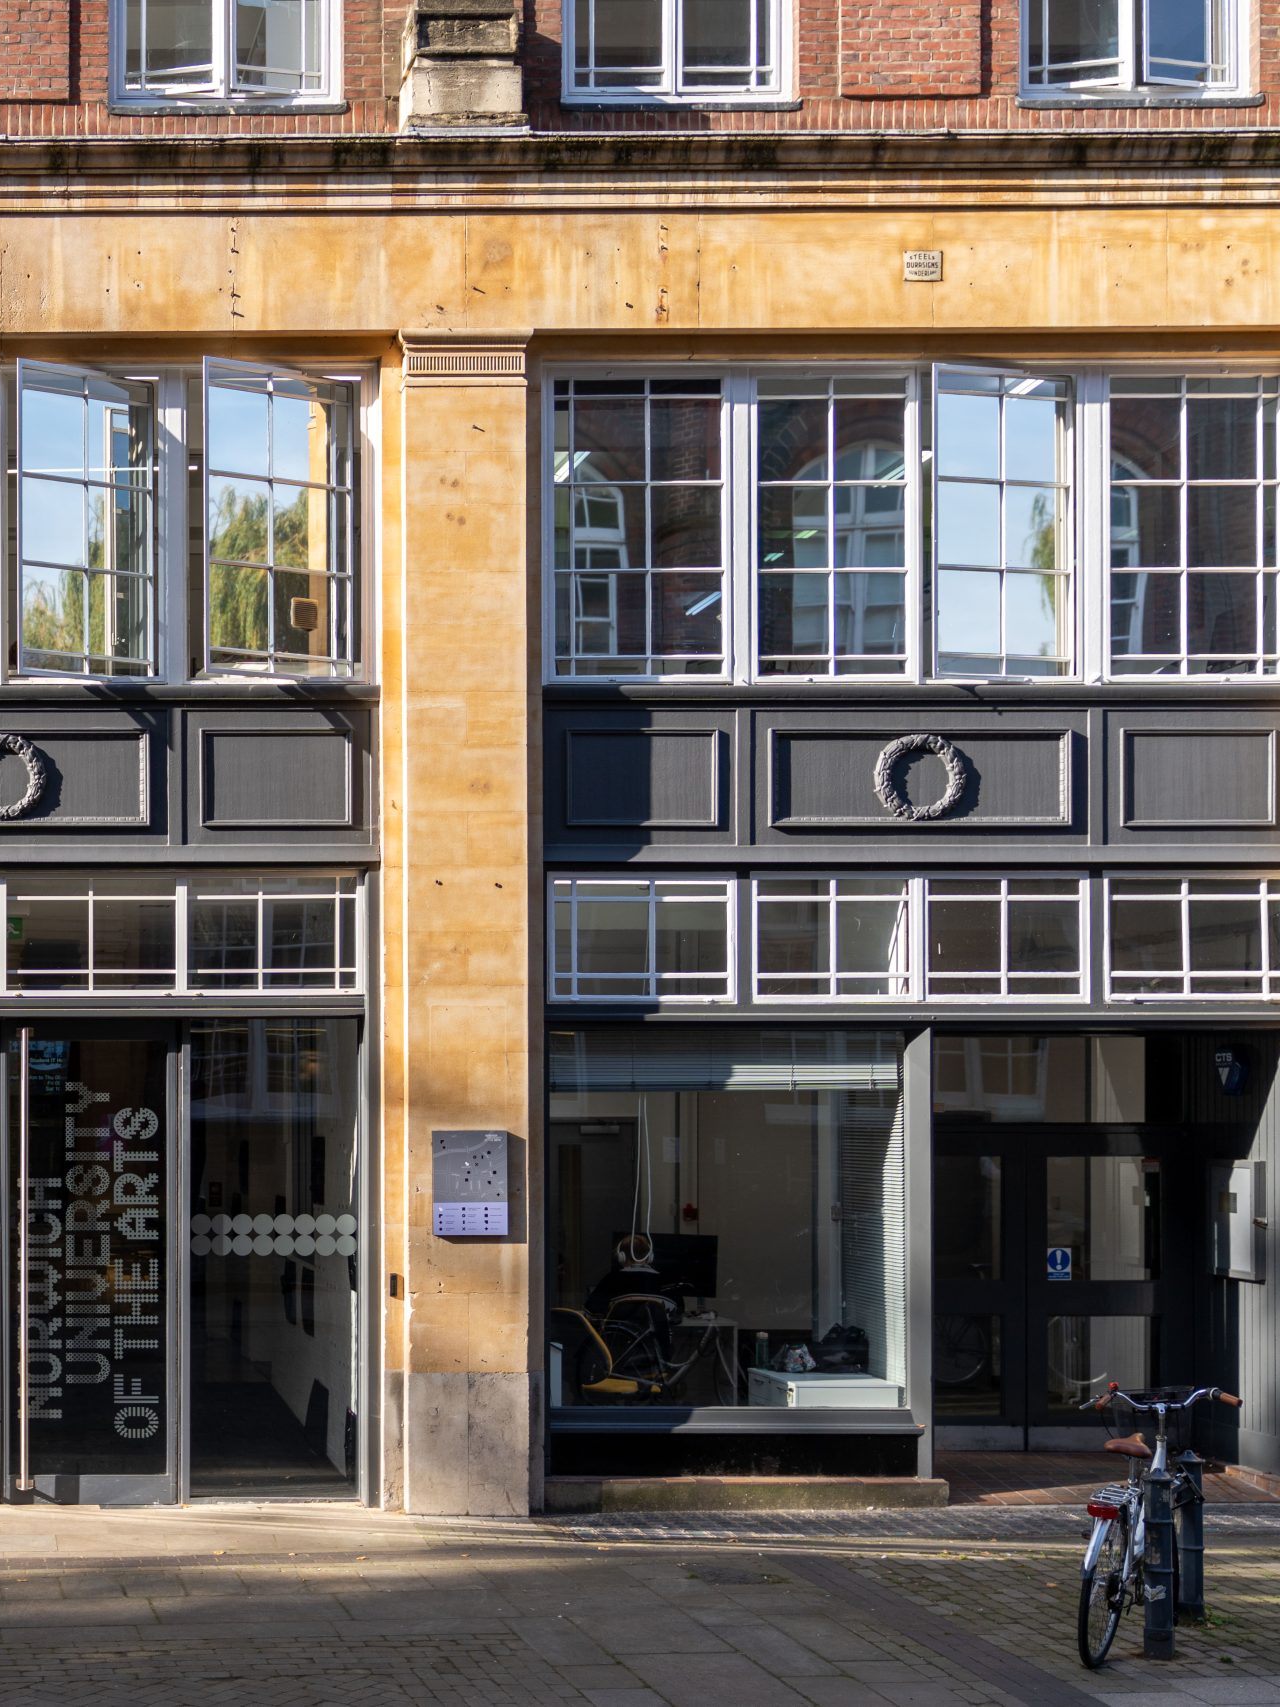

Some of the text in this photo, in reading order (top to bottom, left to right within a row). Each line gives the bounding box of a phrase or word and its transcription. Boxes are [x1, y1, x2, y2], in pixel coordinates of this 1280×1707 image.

[65, 1081, 111, 1384] UNIVERSITY
[113, 1106, 159, 1439] OF THE ARTS
